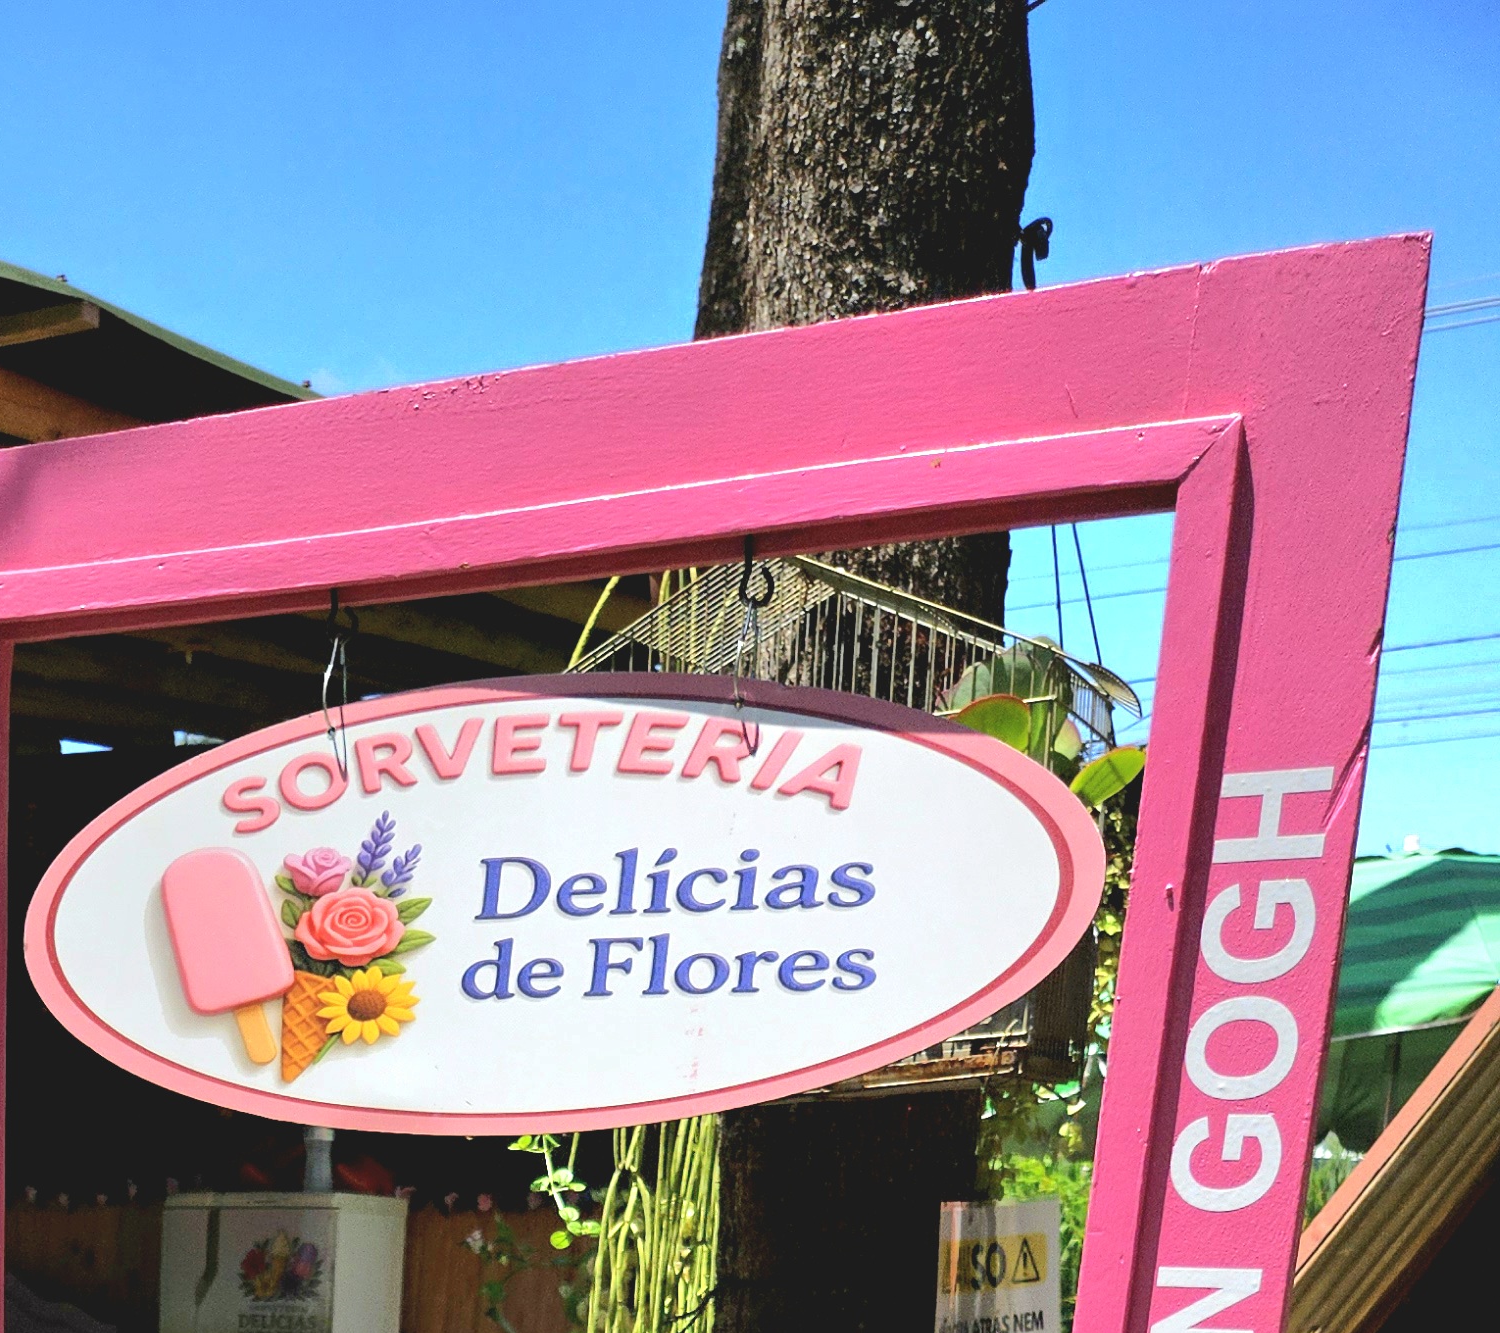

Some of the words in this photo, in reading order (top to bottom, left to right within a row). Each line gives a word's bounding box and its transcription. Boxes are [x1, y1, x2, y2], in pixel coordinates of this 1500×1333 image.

[221, 709, 864, 836] SORVETERIA
[475, 847, 877, 922] Delícias
[461, 938, 563, 1000] de
[584, 935, 876, 998] Flores
[1169, 766, 1335, 1213] GOGH
[1013, 1310, 1044, 1333] NEM
